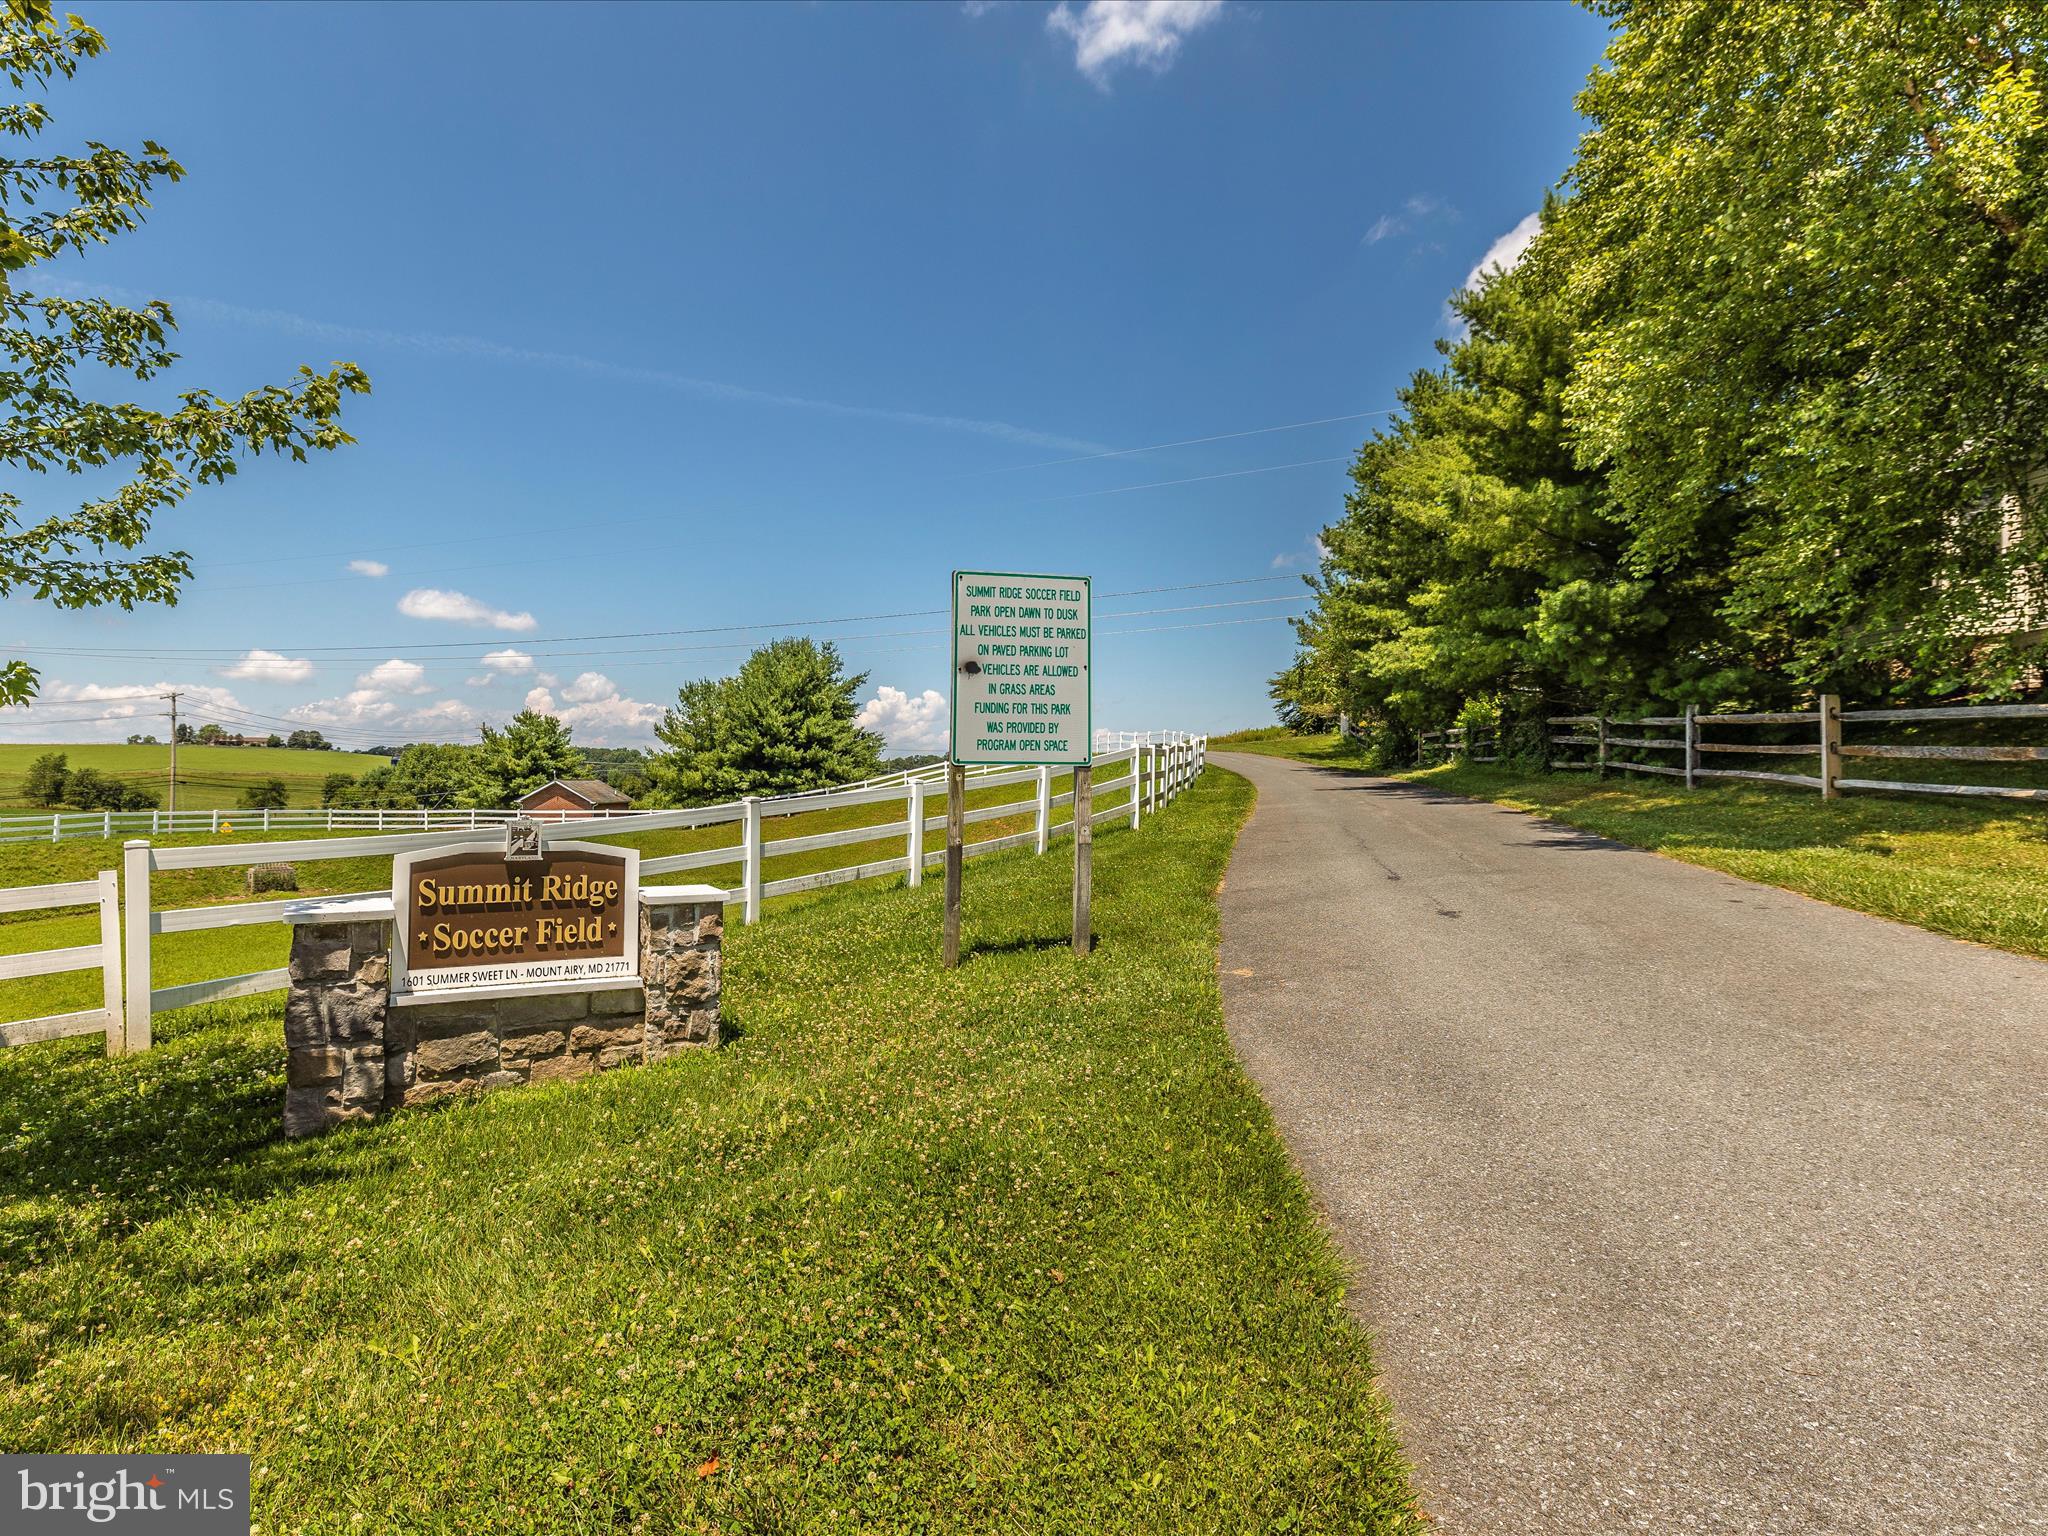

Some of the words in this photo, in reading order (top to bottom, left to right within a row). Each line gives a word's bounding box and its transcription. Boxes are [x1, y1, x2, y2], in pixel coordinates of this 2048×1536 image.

[967, 586, 996, 597] SUMMIT
[1000, 587, 1022, 598] RIDGE
[1026, 588, 1056, 600] SOCCER
[1060, 590, 1080, 601] FIELD
[971, 605, 991, 616] PARK
[995, 606, 1015, 617] OPEN
[1019, 607, 1040, 618] DAWN
[1044, 608, 1053, 619] TO
[1057, 609, 1078, 620] DUSK
[960, 624, 975, 635] ALL
[978, 625, 1016, 636] VEHICLES
[1020, 626, 1040, 637] MUST
[1044, 628, 1054, 638] BE
[1057, 628, 1086, 639] PARKED
[978, 644, 988, 655] ON
[992, 645, 1016, 656] PAVED
[1020, 646, 1052, 657] PARKING
[1055, 647, 1068, 658] LOT
[982, 664, 1020, 675] VEHICLES
[1024, 665, 1039, 675] ARE
[1042, 665, 1078, 677] ALLOWED
[988, 683, 996, 694] IN
[1000, 684, 1026, 695] GRASS
[1029, 684, 1055, 695] AREAS
[975, 702, 1009, 714] FUNDING
[1012, 703, 1027, 714] FOR
[1031, 703, 1048, 714] THIS
[1051, 704, 1070, 715] PARK
[987, 722, 1003, 733] WAS
[1007, 722, 1045, 733] PROVIDED
[1049, 723, 1059, 733] BY
[977, 739, 1016, 750] PROGRAM
[1020, 740, 1040, 751] OPEN
[1044, 740, 1068, 751] SPACE
[418, 877, 532, 907] Summit
[540, 875, 618, 906] Ridge
[433, 923, 528, 951] Soccer
[536, 917, 602, 945] Field
[401, 976, 423, 987] 1601
[427, 973, 470, 985] SUMMER
[473, 970, 503, 981] SWEET
[506, 970, 518, 979] LN
[526, 966, 563, 977] MOUNT
[564, 964, 585, 976] AIRY,
[588, 963, 602, 973] MD
[606, 962, 630, 971] 21771
